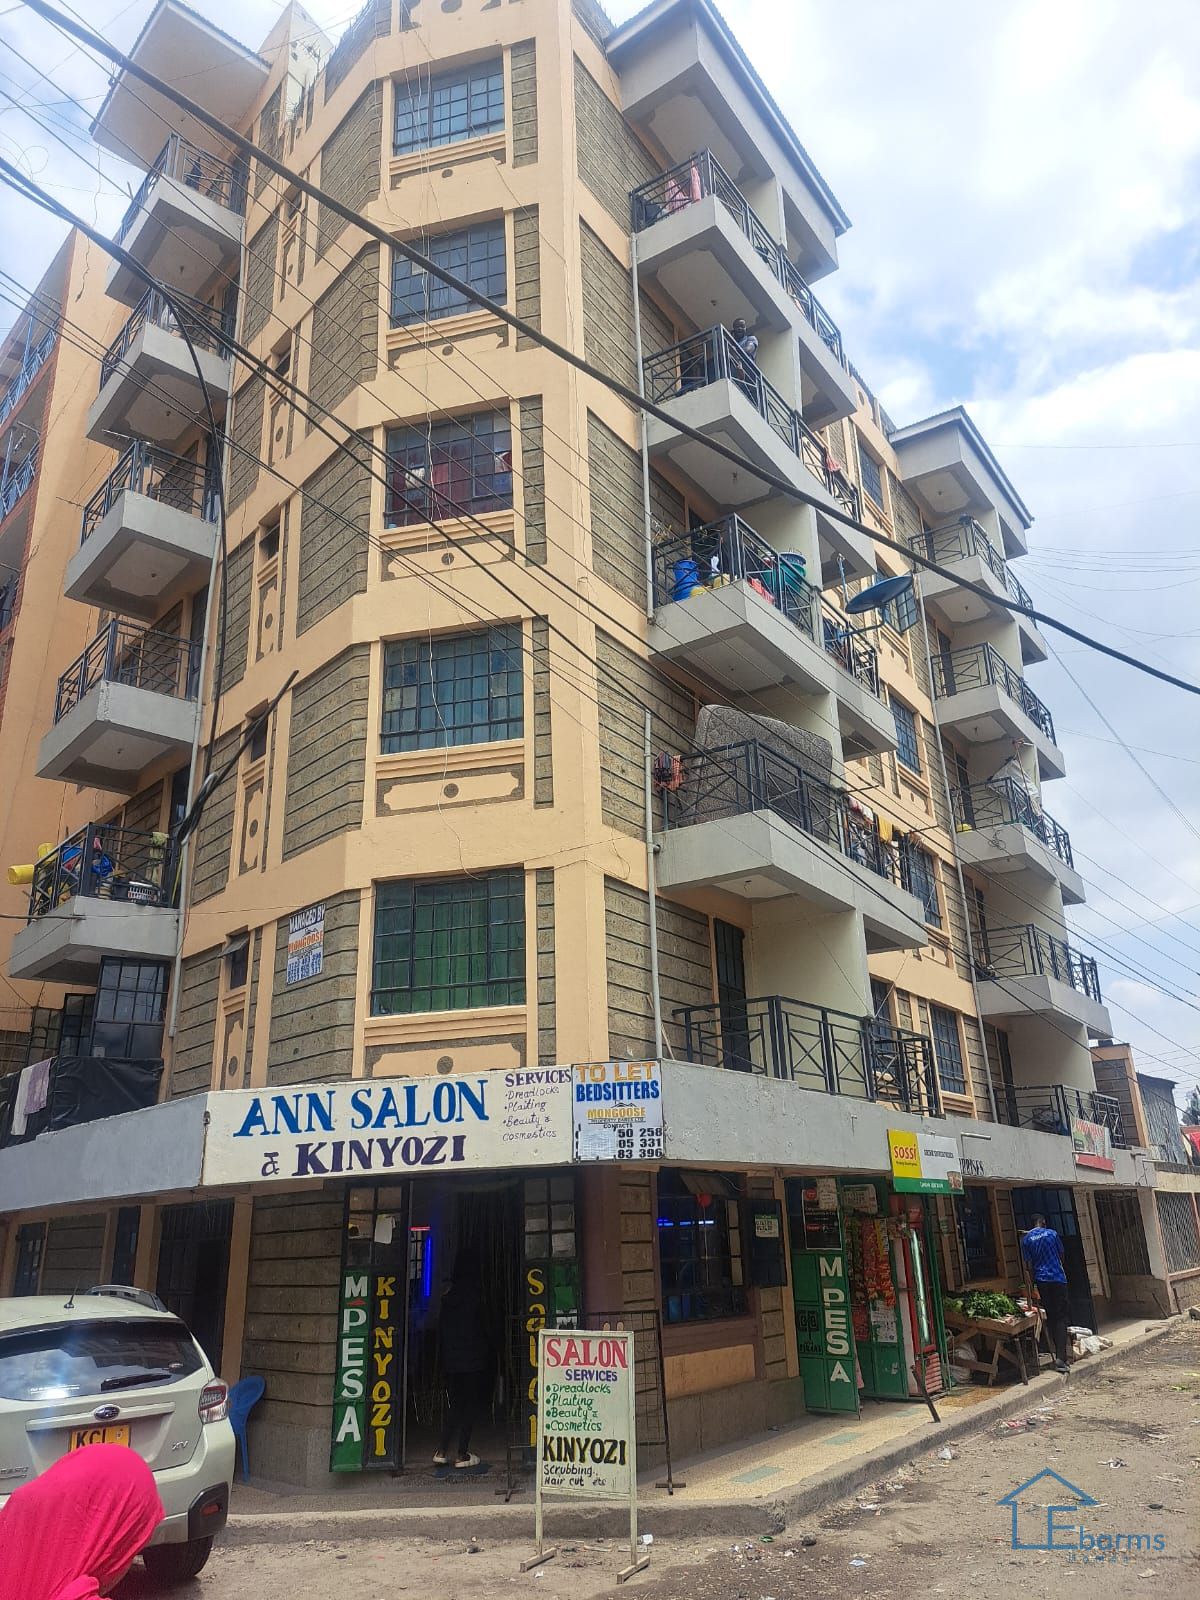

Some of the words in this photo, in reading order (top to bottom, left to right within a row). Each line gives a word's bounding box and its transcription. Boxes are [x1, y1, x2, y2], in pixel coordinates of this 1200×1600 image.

[317, 903, 326, 922] BY
[504, 1068, 572, 1088] SERVICES
[575, 1064, 606, 1083] TO
[614, 1062, 656, 1081] LET
[575, 1080, 660, 1102] BEDSITTERS
[233, 1094, 338, 1138] ANN
[350, 1079, 490, 1129] SALON
[506, 1099, 547, 1113] Plaiting
[587, 1106, 646, 1119] MONGOOSE
[506, 1112, 541, 1128] Beauty
[617, 1128, 634, 1138] 50
[639, 1128, 663, 1138] 258
[618, 1139, 635, 1149] 05
[640, 1138, 662, 1148] 331
[291, 1135, 467, 1177] KINYOZI
[617, 1150, 633, 1159] 83
[639, 1148, 663, 1159] 396
[547, 1337, 629, 1369] SALON
[371, 1276, 396, 1457] KINYOZI
[565, 1368, 618, 1382] SERVICES
[551, 1383, 612, 1394] Dreadlocks
[551, 1392, 594, 1410] Plaiting
[551, 1406, 588, 1418] Beauty
[550, 1419, 603, 1432] Cosmetics
[542, 1434, 627, 1466] KINYOZI
[544, 1476, 566, 1486] Hair
[569, 1476, 585, 1487] cut
